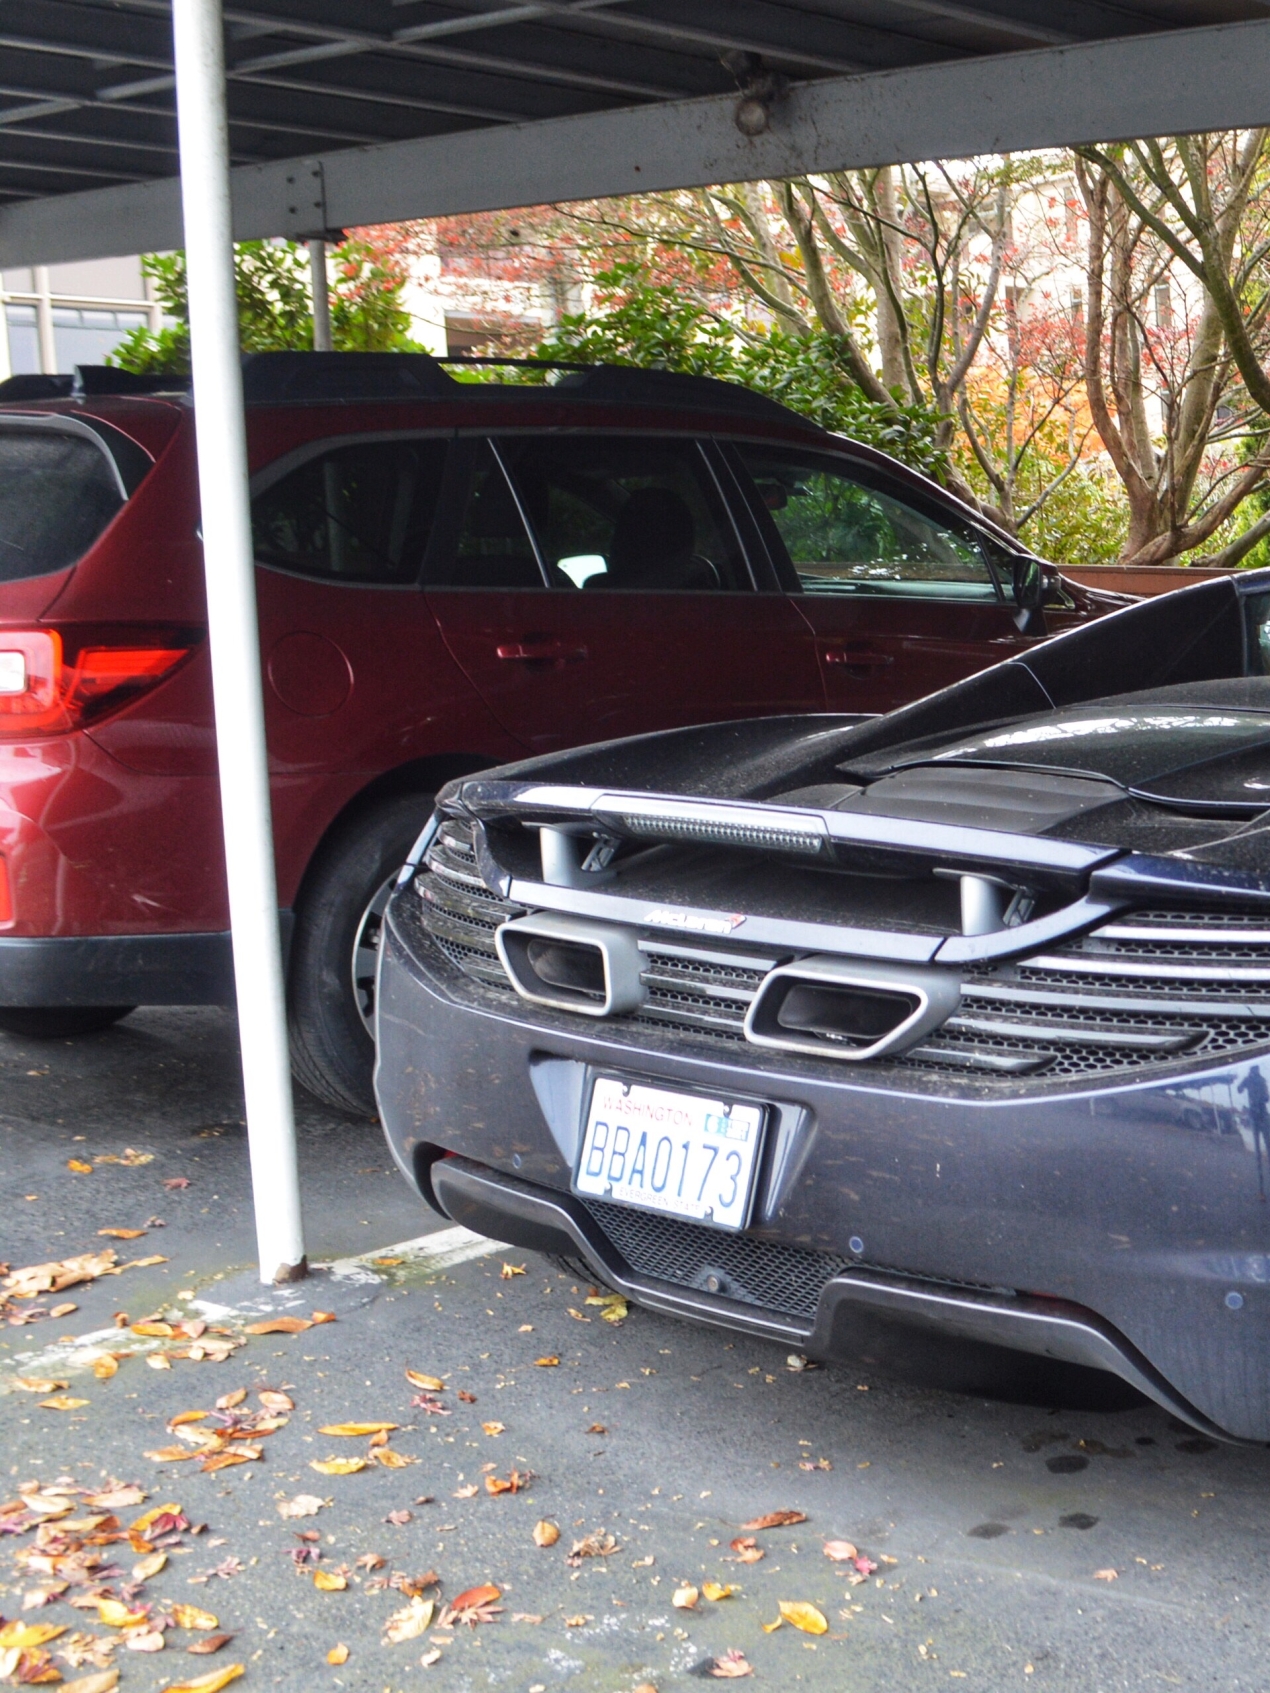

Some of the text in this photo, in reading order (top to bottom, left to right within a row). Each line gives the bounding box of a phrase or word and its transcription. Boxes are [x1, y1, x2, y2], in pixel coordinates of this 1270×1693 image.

[603, 1095, 693, 1127] WASHINGTON
[586, 1121, 742, 1208] BBA0173
[618, 1186, 700, 1213] EVERGREEN STATE
